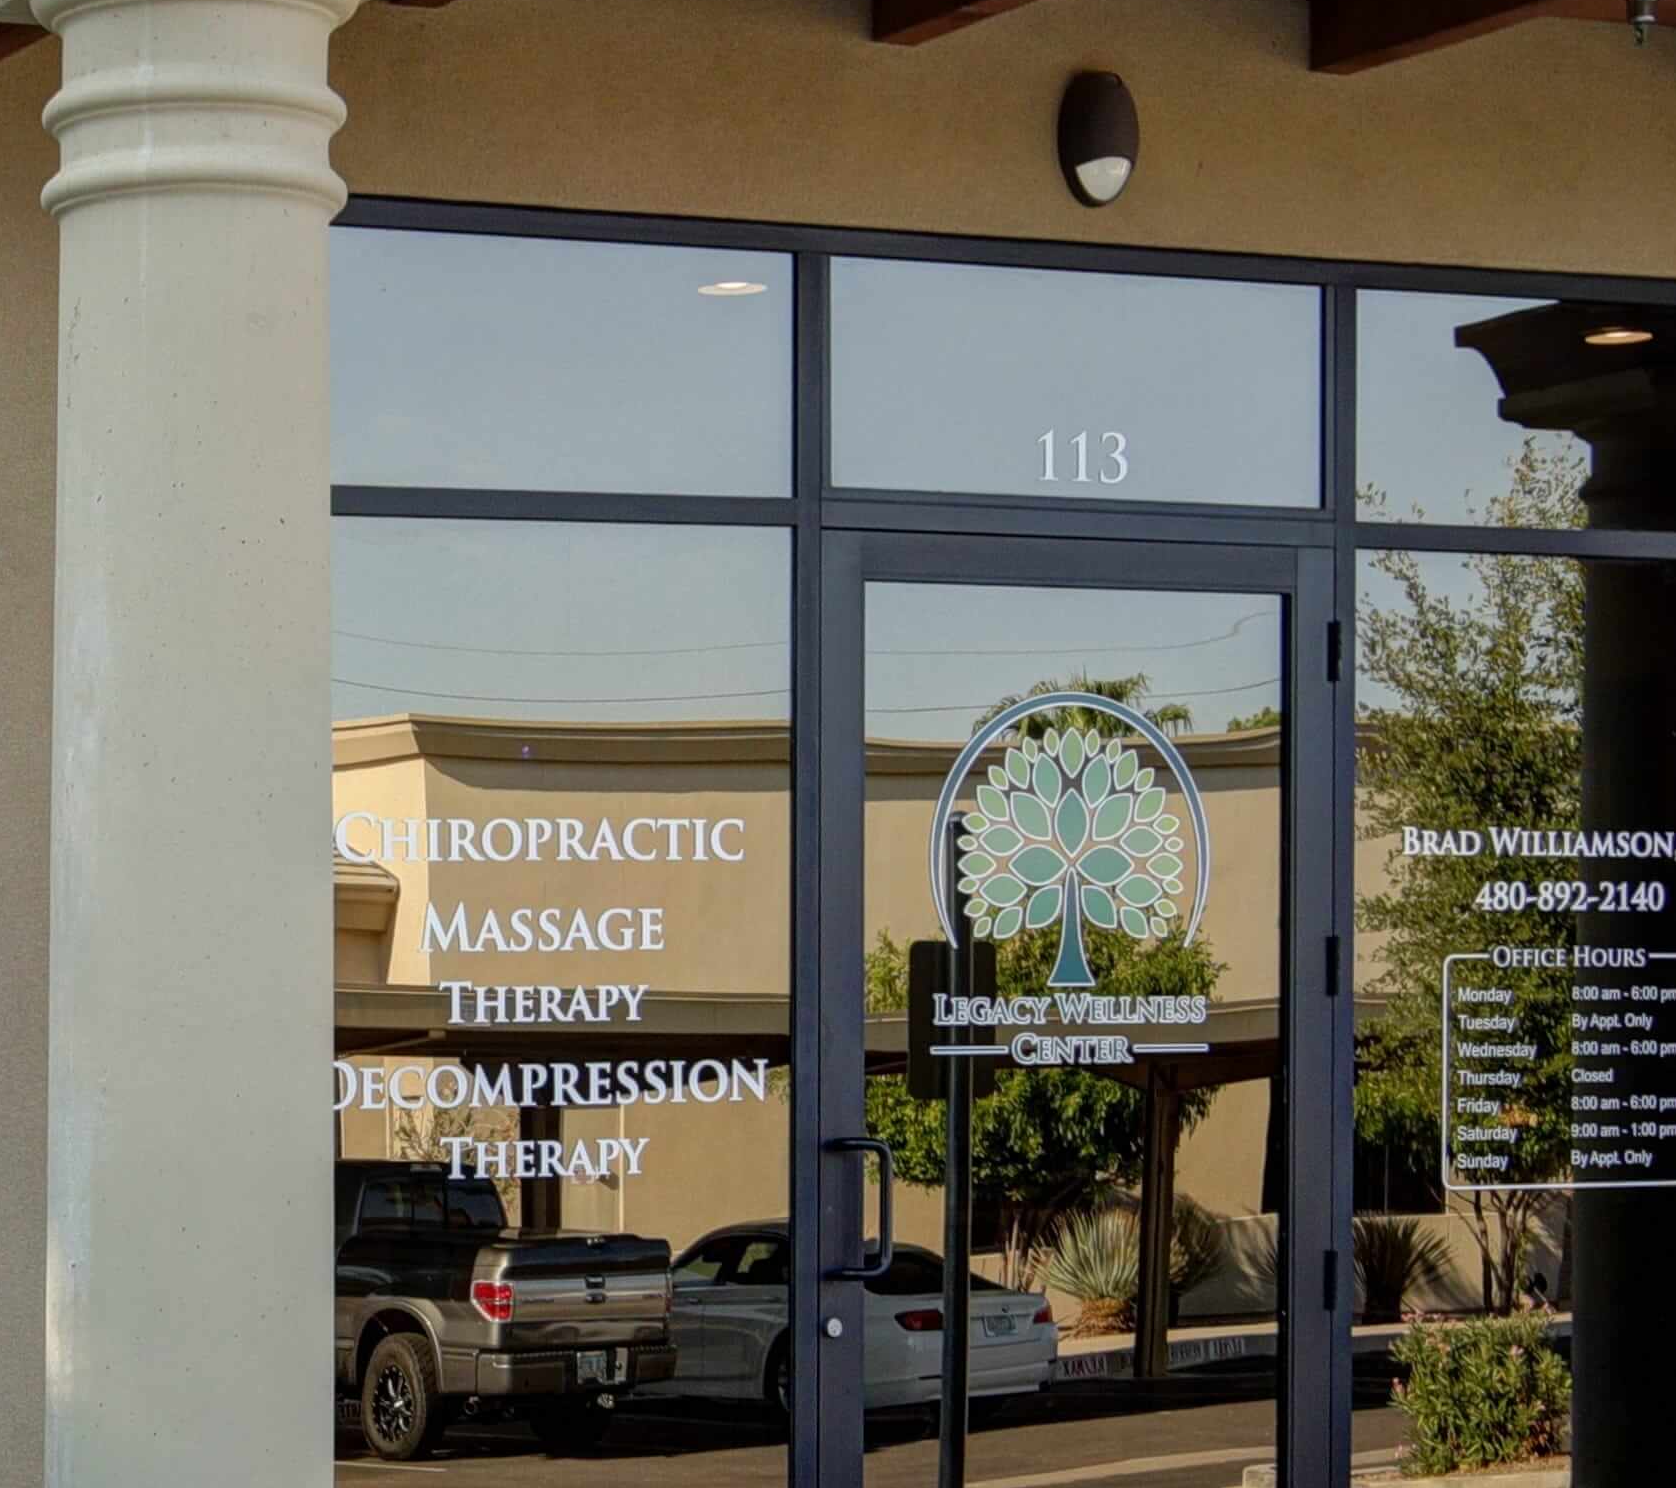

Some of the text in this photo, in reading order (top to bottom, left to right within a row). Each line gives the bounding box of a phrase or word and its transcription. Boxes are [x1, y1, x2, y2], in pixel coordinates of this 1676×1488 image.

[1038, 429, 1128, 484] 113
[334, 812, 744, 863] CHIROPRACTIC
[1403, 826, 1481, 857] BRAD
[1476, 881, 1664, 911] 480-892-2140
[419, 901, 665, 953] MASSAGE
[1493, 946, 1646, 968] OFFICE HOURS
[440, 981, 649, 1024] THERAPY
[933, 993, 1207, 1025] LEGACY WELLNESS
[1458, 987, 1512, 1005] Monday
[1572, 987, 1598, 1000] 8:00
[1601, 990, 1621, 1000] am
[1631, 987, 1657, 1000] 6:00
[1458, 1013, 1653, 1033] Tuesday By Appt. Only
[1011, 1032, 1133, 1065] CENTER
[1458, 1042, 1537, 1059] Wednesday
[1571, 1042, 1597, 1055] 8:00
[1601, 1045, 1620, 1054] am
[1631, 1041, 1657, 1054] 6:00
[334, 1059, 768, 1110] DECOMPRESSION
[1458, 1068, 1613, 1088] Thursday Closed
[1458, 1098, 1500, 1115] Friday
[1571, 1096, 1597, 1110] 8:00
[1600, 1099, 1620, 1109] am
[1630, 1096, 1656, 1109] 6:00
[1458, 1127, 1518, 1143] Saturday
[1571, 1124, 1597, 1137] 9:00
[1600, 1127, 1620, 1137] am
[1632, 1124, 1656, 1137] 1:00
[440, 1136, 649, 1179] THERAPY
[1457, 1150, 1652, 1170] Sunday By Appt. Only
